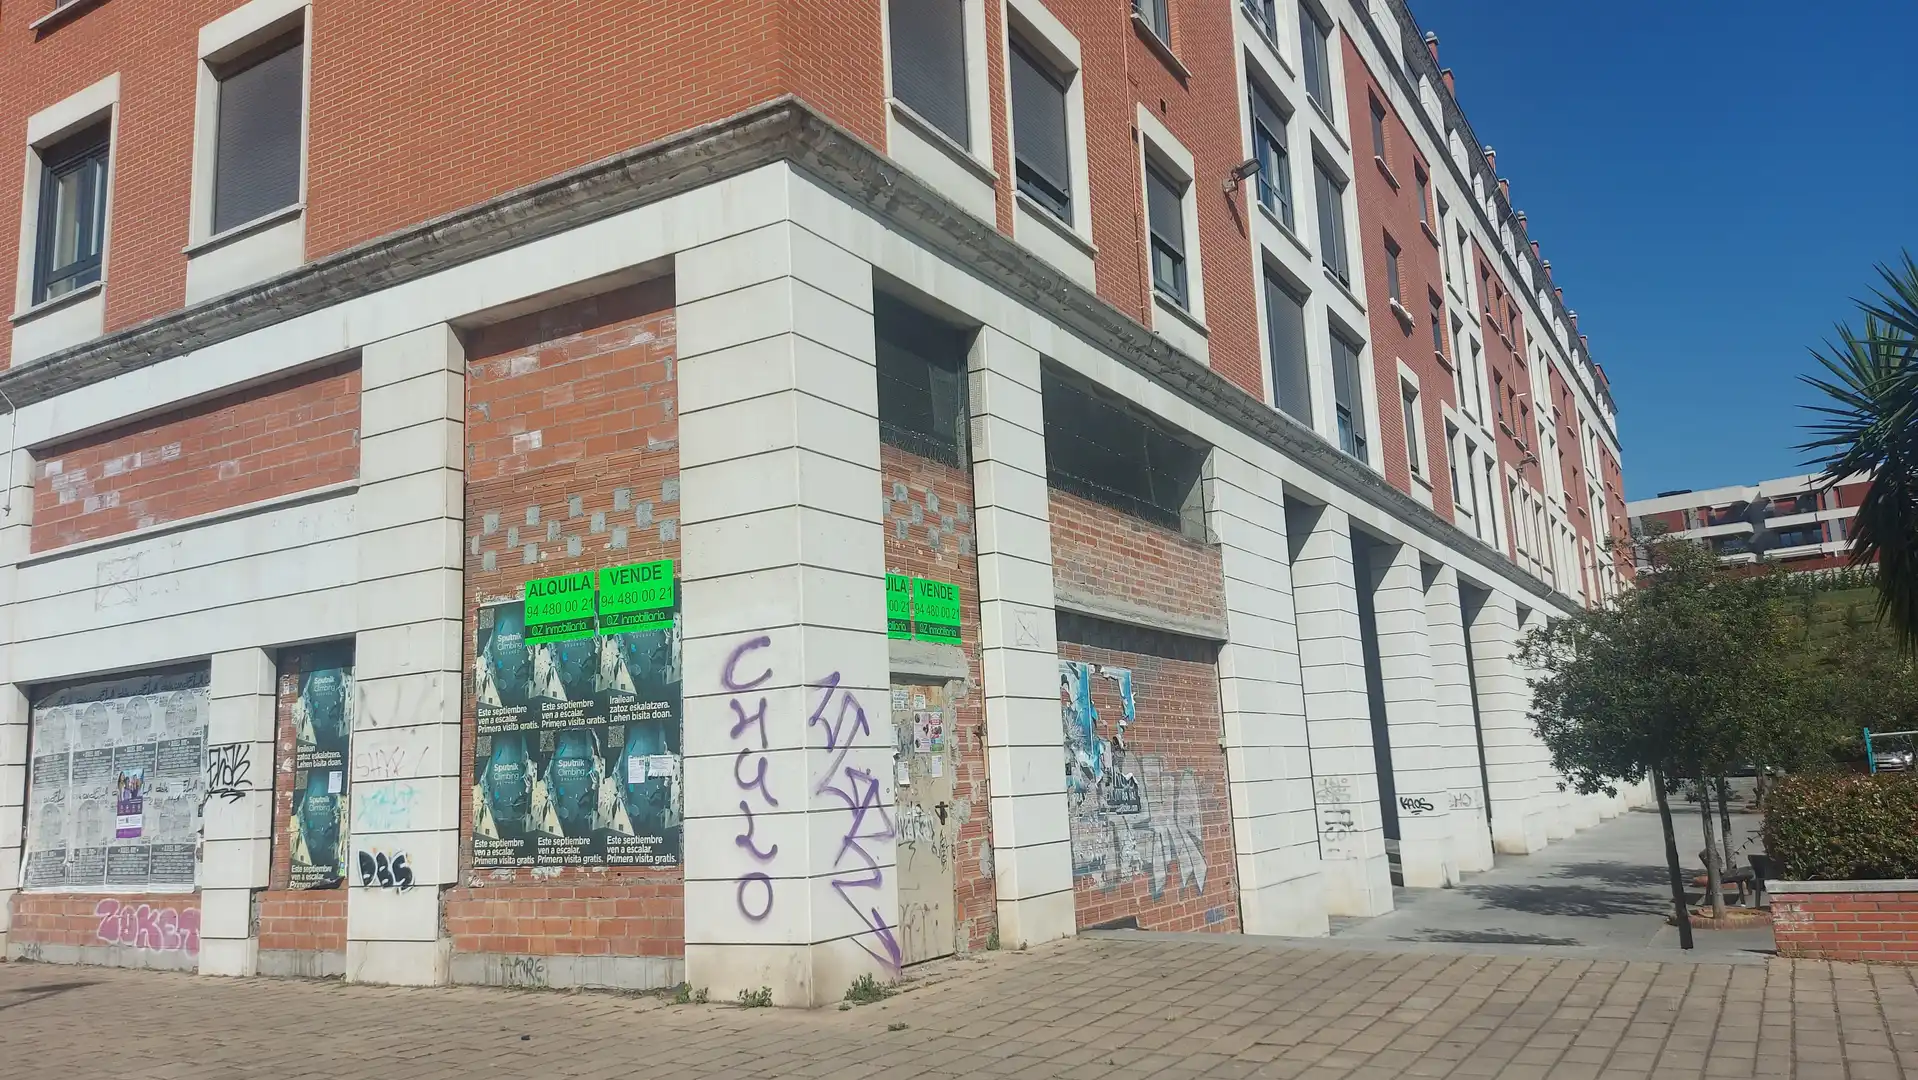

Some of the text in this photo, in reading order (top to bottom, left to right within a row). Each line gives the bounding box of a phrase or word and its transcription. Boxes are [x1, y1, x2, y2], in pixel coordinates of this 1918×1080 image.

[609, 564, 662, 586] VENDE
[528, 575, 591, 598] ALQUILA
[886, 576, 907, 593] UILA
[601, 585, 672, 607] 94 480 00 21
[920, 581, 954, 601] VENDE
[527, 597, 593, 618] 94 480 00 21
[889, 599, 899, 612] 00
[915, 602, 960, 620] 94 480 00 21
[497, 632, 522, 643] Sputnik
[497, 640, 523, 652] Climbing
[541, 699, 594, 711] Este septiembre
[609, 695, 635, 704] Irailean
[478, 705, 528, 717] Este septiembre
[609, 701, 670, 713] zatoz eskalatzera.
[560, 709, 584, 718] escalar.
[609, 710, 672, 722] Lehen bisita doan.
[478, 717, 489, 725] ven
[495, 715, 518, 724] escalar.
[541, 715, 607, 728] Primera visita gratis.
[478, 721, 540, 734] Primera visita gratis.
[493, 762, 519, 772] Sputnik
[558, 758, 585, 768] Sputnik
[493, 771, 520, 782] Climbing
[558, 767, 585, 777] Climbing
[1400, 796, 1434, 811] KAOS
[474, 837, 525, 849] Este septiembre
[538, 835, 591, 847] Este septiembre
[607, 834, 663, 846] Este septiembre
[486, 848, 491, 856] a
[492, 846, 515, 856] escalar.
[557, 845, 581, 854] escalar.
[607, 844, 653, 854] ven a escalar.
[474, 855, 535, 866] Primera visita gratis
[537, 853, 604, 865] Primera visita gratis.
[607, 853, 677, 865] Primera visita gratis.
[291, 864, 333, 874] Este septiembre
